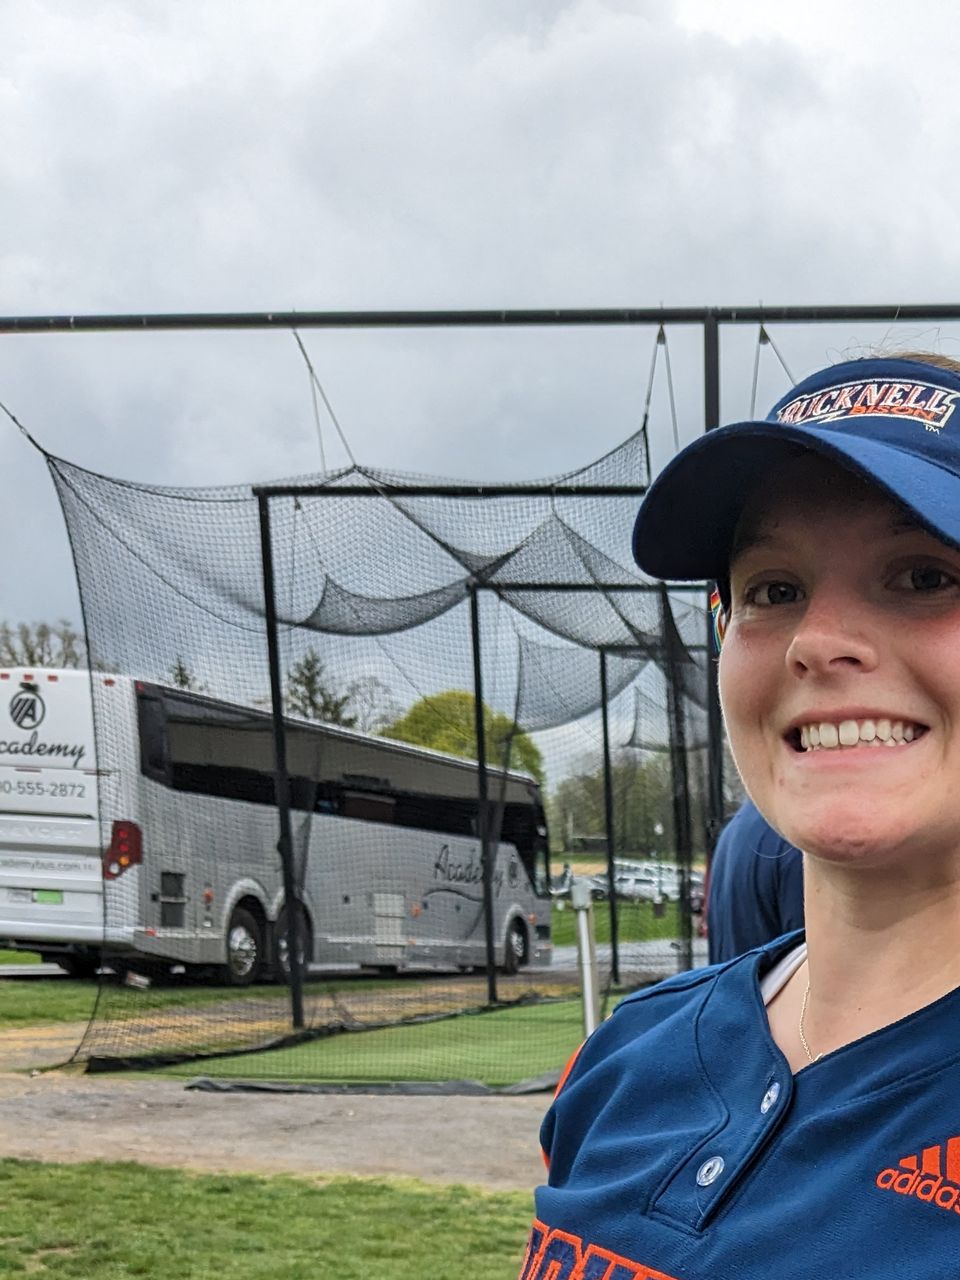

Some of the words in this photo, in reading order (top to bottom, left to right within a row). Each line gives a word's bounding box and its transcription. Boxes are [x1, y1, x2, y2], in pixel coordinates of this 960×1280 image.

[849, 405, 936, 421] BISON
[0, 780, 87, 799] 0-555-2872
[434, 843, 504, 898] Acadey
